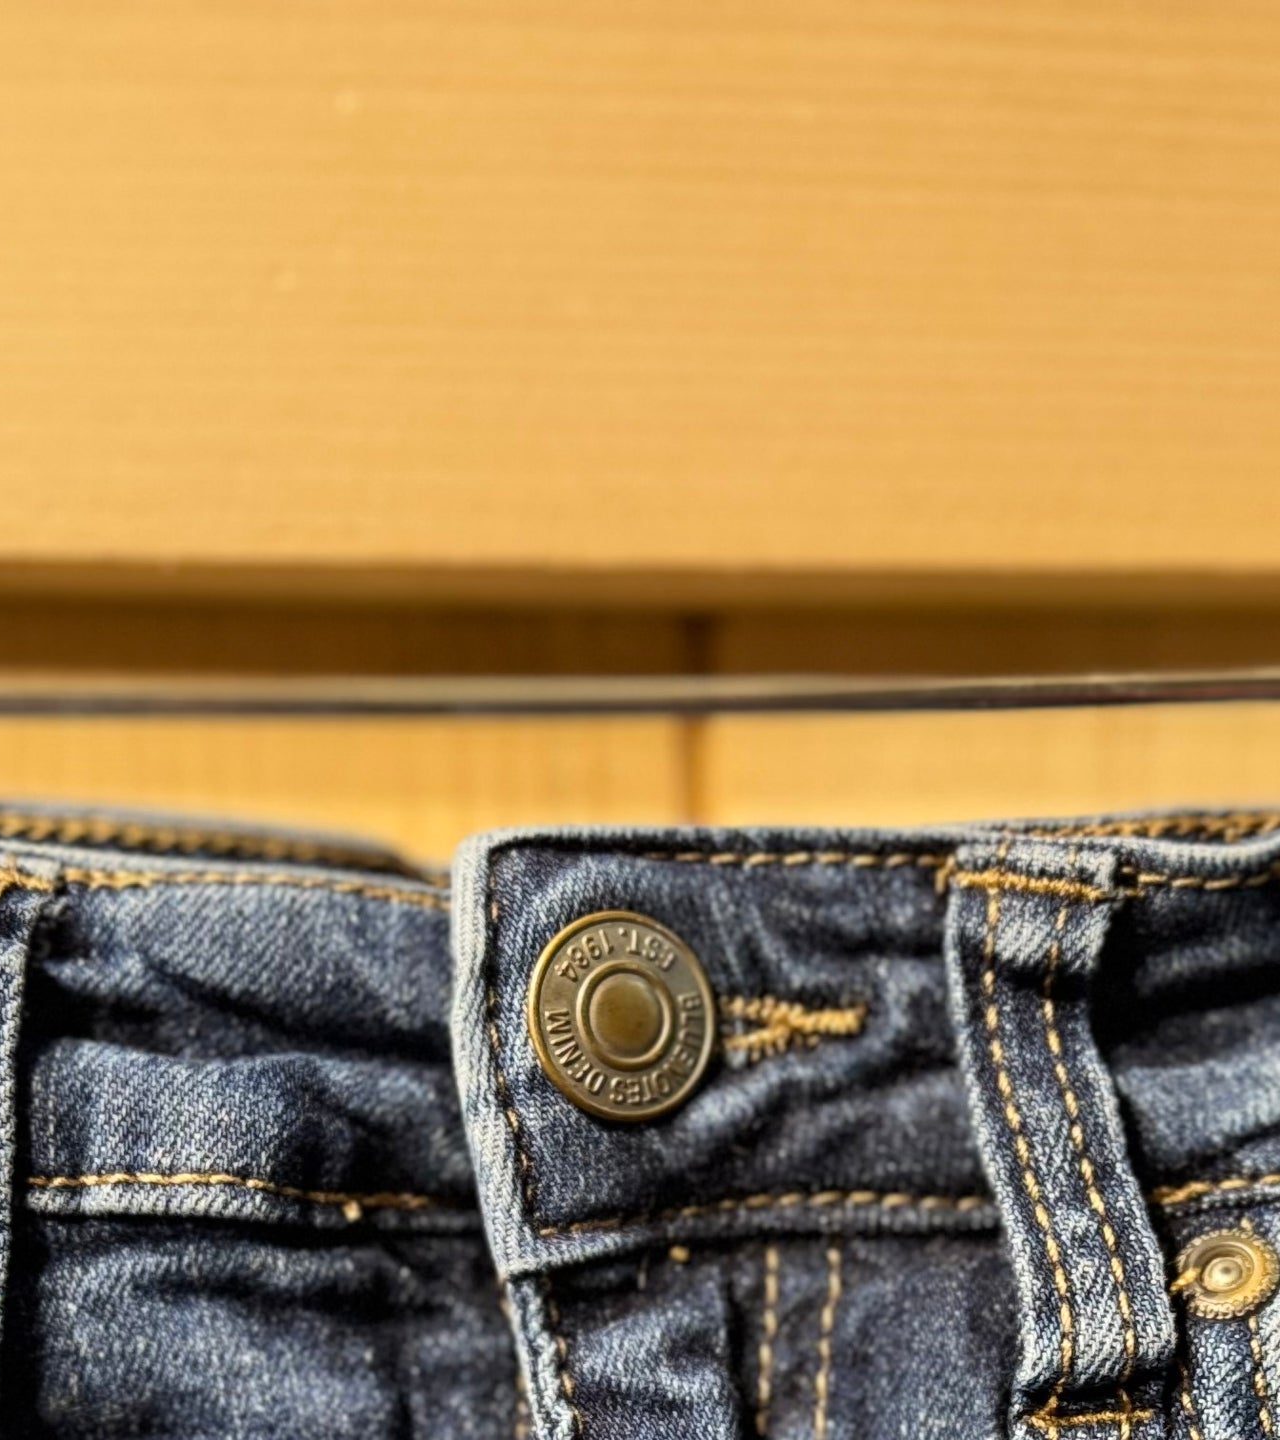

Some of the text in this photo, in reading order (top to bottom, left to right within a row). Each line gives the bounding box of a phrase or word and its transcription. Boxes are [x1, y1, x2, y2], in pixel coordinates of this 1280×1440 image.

[554, 928, 614, 983] 1984
[544, 991, 703, 1105] BLUENOTES DENIM
